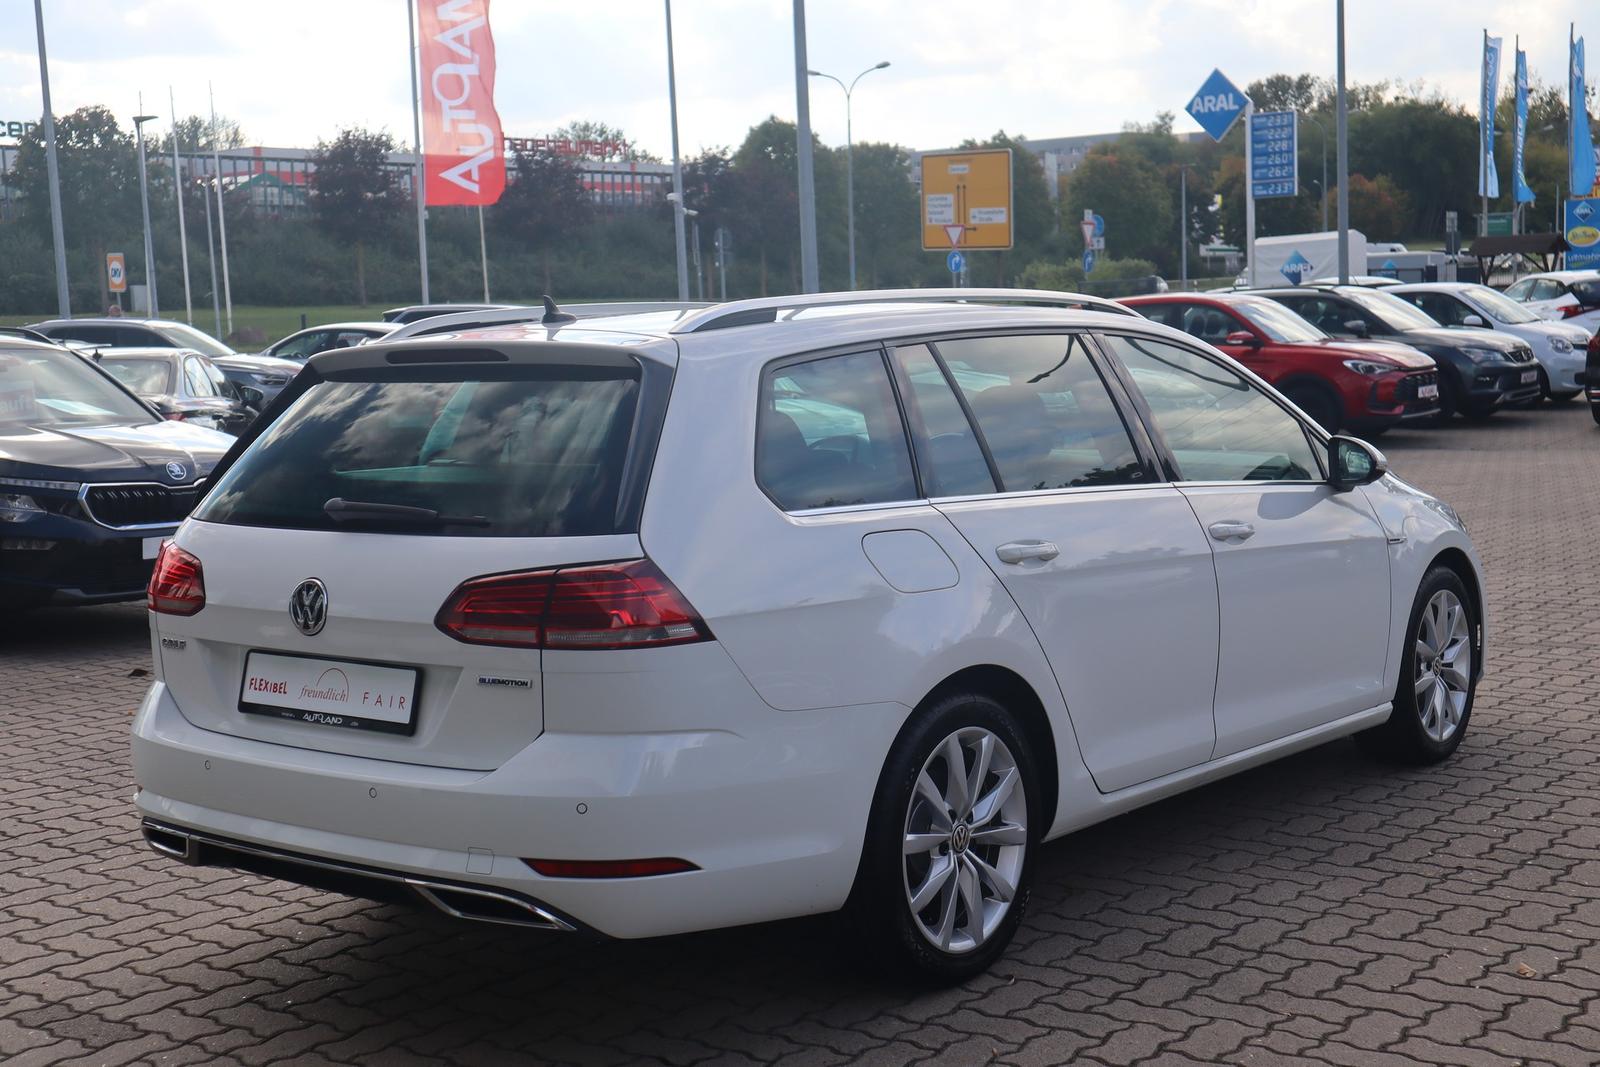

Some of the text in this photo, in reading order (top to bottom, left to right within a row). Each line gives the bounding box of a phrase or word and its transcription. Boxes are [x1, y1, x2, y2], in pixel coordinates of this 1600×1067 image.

[1192, 93, 1239, 114] ARAL
[249, 677, 288, 695] FLEXIBEL
[298, 685, 347, 703] freundlich
